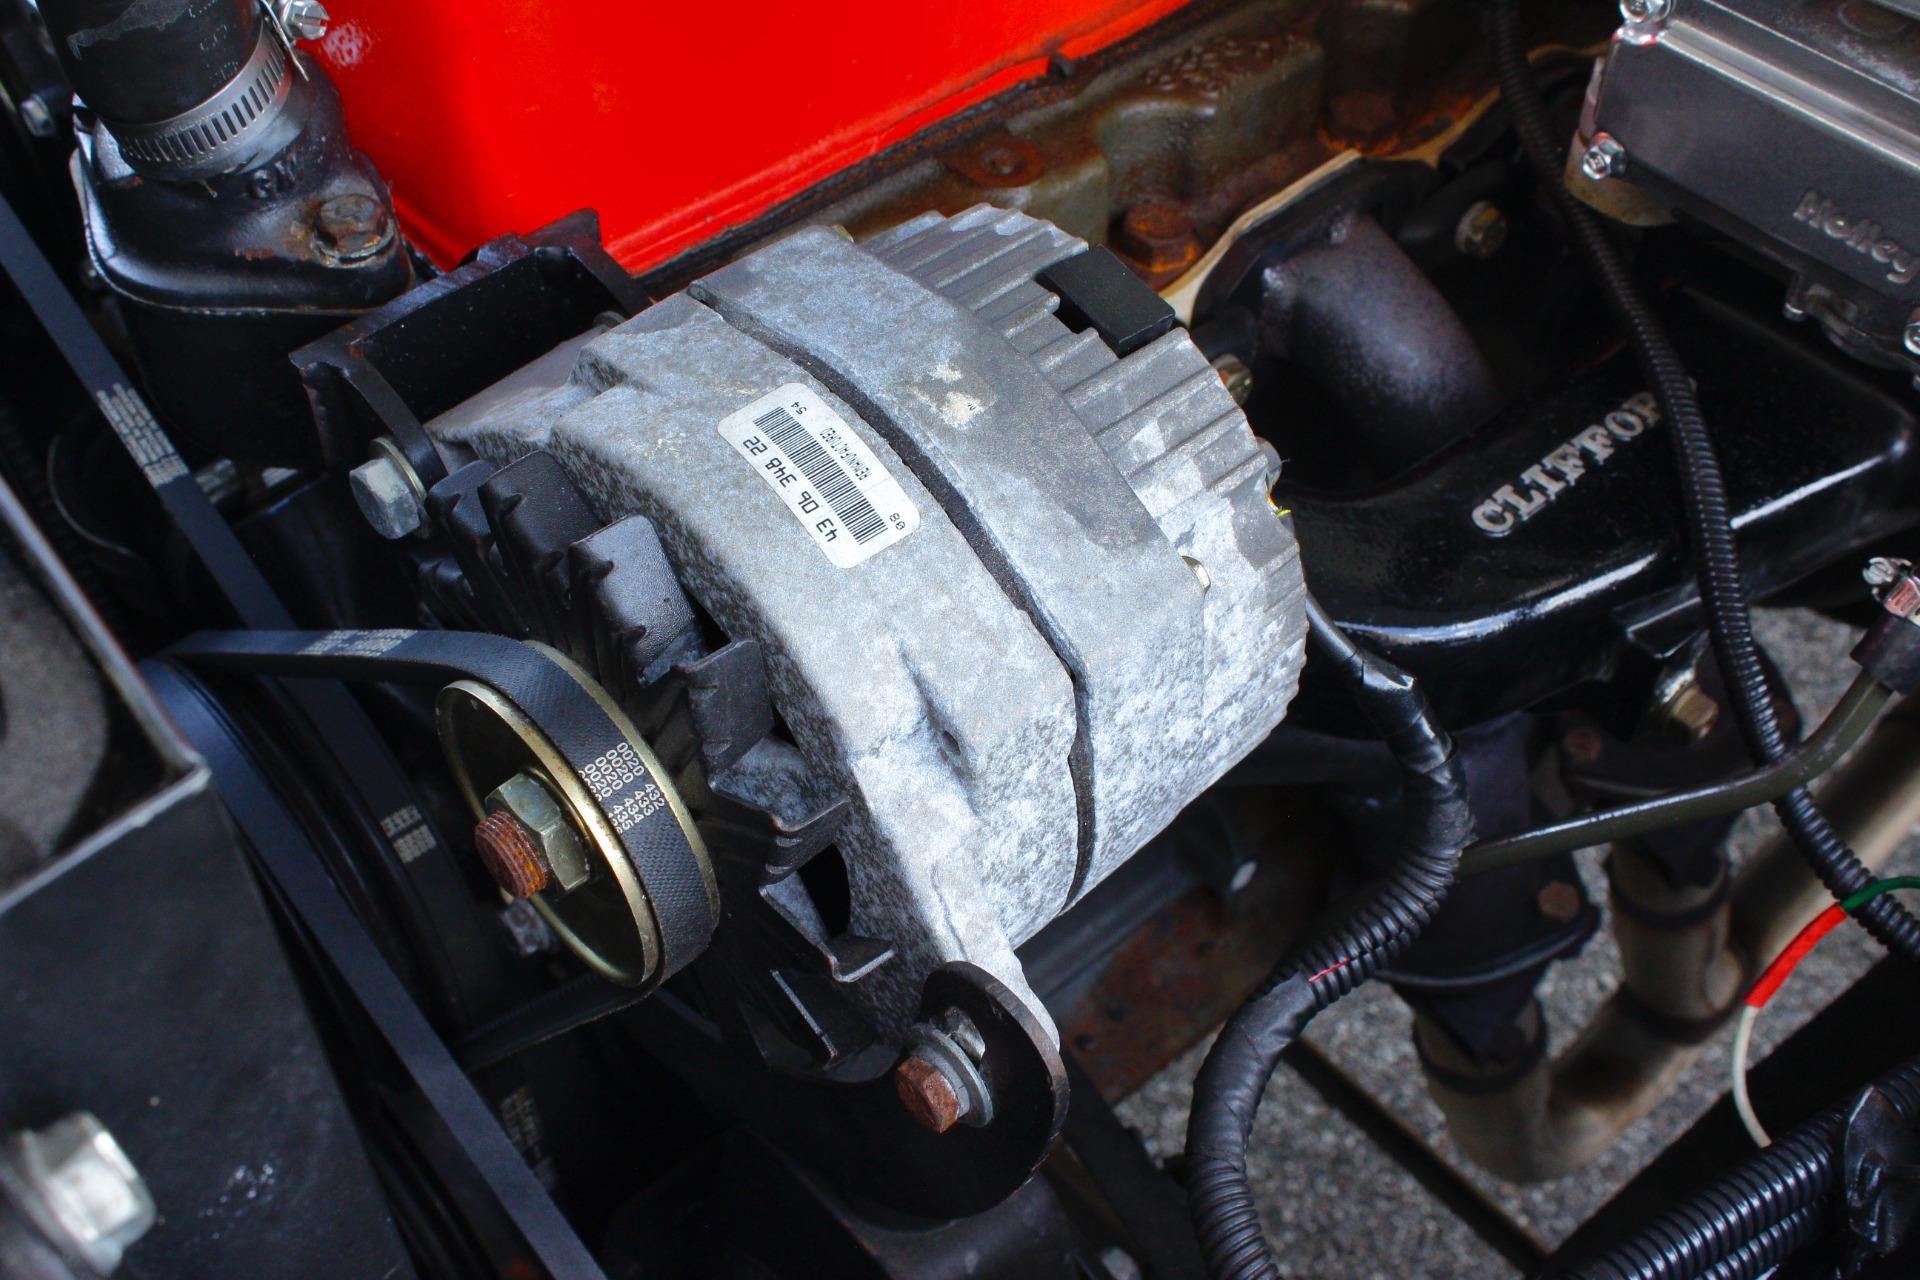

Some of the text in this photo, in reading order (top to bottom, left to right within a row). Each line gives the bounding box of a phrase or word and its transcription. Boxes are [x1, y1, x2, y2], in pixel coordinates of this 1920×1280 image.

[1793, 190, 1919, 284] Holley
[790, 401, 807, 415] 54
[742, 435, 768, 456] 22
[765, 457, 797, 488] 348
[819, 427, 872, 481] REMANUFACTURED
[1472, 392, 1660, 537] CLIFFOR
[816, 518, 838, 542] 43
[584, 763, 613, 797] 0020
[612, 805, 634, 830] 435
[595, 756, 623, 790] 0020
[623, 797, 644, 823] 434
[606, 749, 655, 816] 0020 433
[616, 742, 665, 810] 0020 432
